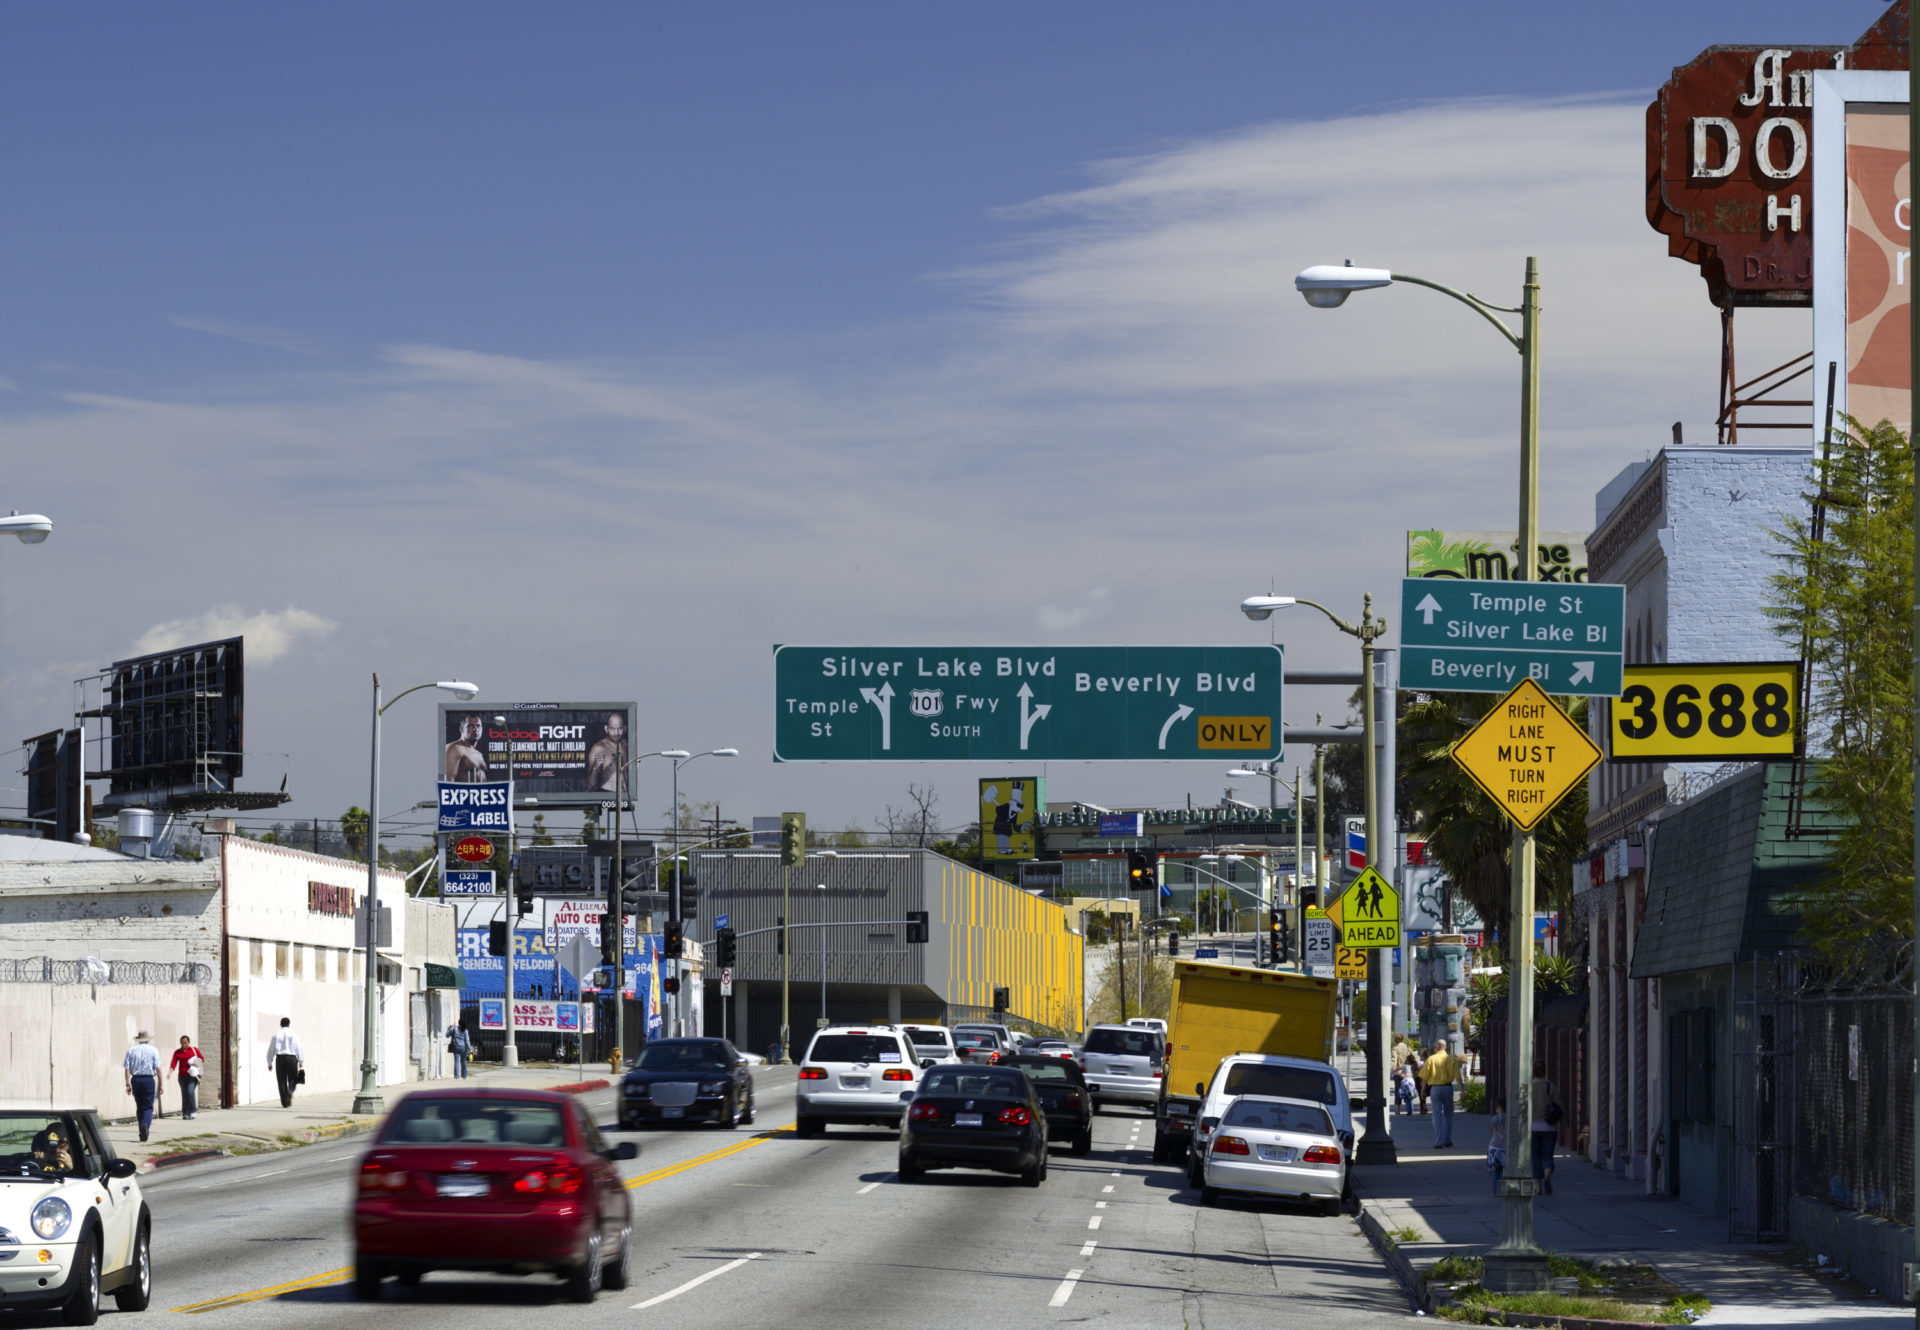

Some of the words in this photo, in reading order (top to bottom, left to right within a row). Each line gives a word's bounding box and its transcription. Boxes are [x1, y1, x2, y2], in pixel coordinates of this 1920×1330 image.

[1469, 592, 1547, 616] Temple
[1558, 595, 1584, 614] St
[1446, 620, 1510, 640] Silver
[1522, 622, 1574, 642] Lake
[1586, 625, 1607, 643] Bl
[822, 656, 903, 677] Silver
[918, 657, 983, 677] Lake
[997, 656, 1056, 677] Blvd
[1430, 658, 1517, 683] Beverly
[1528, 662, 1549, 681] Bl
[1075, 672, 1181, 697] Beverly
[1196, 672, 1255, 692] Blvd
[786, 698, 859, 716] Temple
[914, 696, 939, 711] 101
[956, 695, 999, 713] Fwy
[1618, 682, 1791, 740] 3688
[1508, 704, 1546, 720] RIGHT
[810, 722, 833, 737] St
[930, 722, 981, 737] SOUTH
[1202, 724, 1267, 742] ONLY
[1509, 725, 1545, 740] LANE
[505, 742, 537, 751] EELIANENKO
[1498, 746, 1556, 763] MUST
[1509, 769, 1545, 783] TURN
[441, 788, 506, 806] EXPRESS
[1507, 789, 1546, 804] RIGHT
[470, 811, 508, 826] LABEL
[1039, 806, 1123, 825] WESTE
[1142, 807, 1273, 822] XTERMINATOR
[459, 873, 479, 881] (323)
[555, 912, 580, 924] AUTO
[1347, 927, 1396, 941] AHEAD
[1308, 938, 1330, 951] 25
[1338, 948, 1367, 967] 25
[1340, 969, 1364, 978] MPH
[513, 1004, 537, 1015] ASS
[514, 1015, 555, 1027] ETEST
